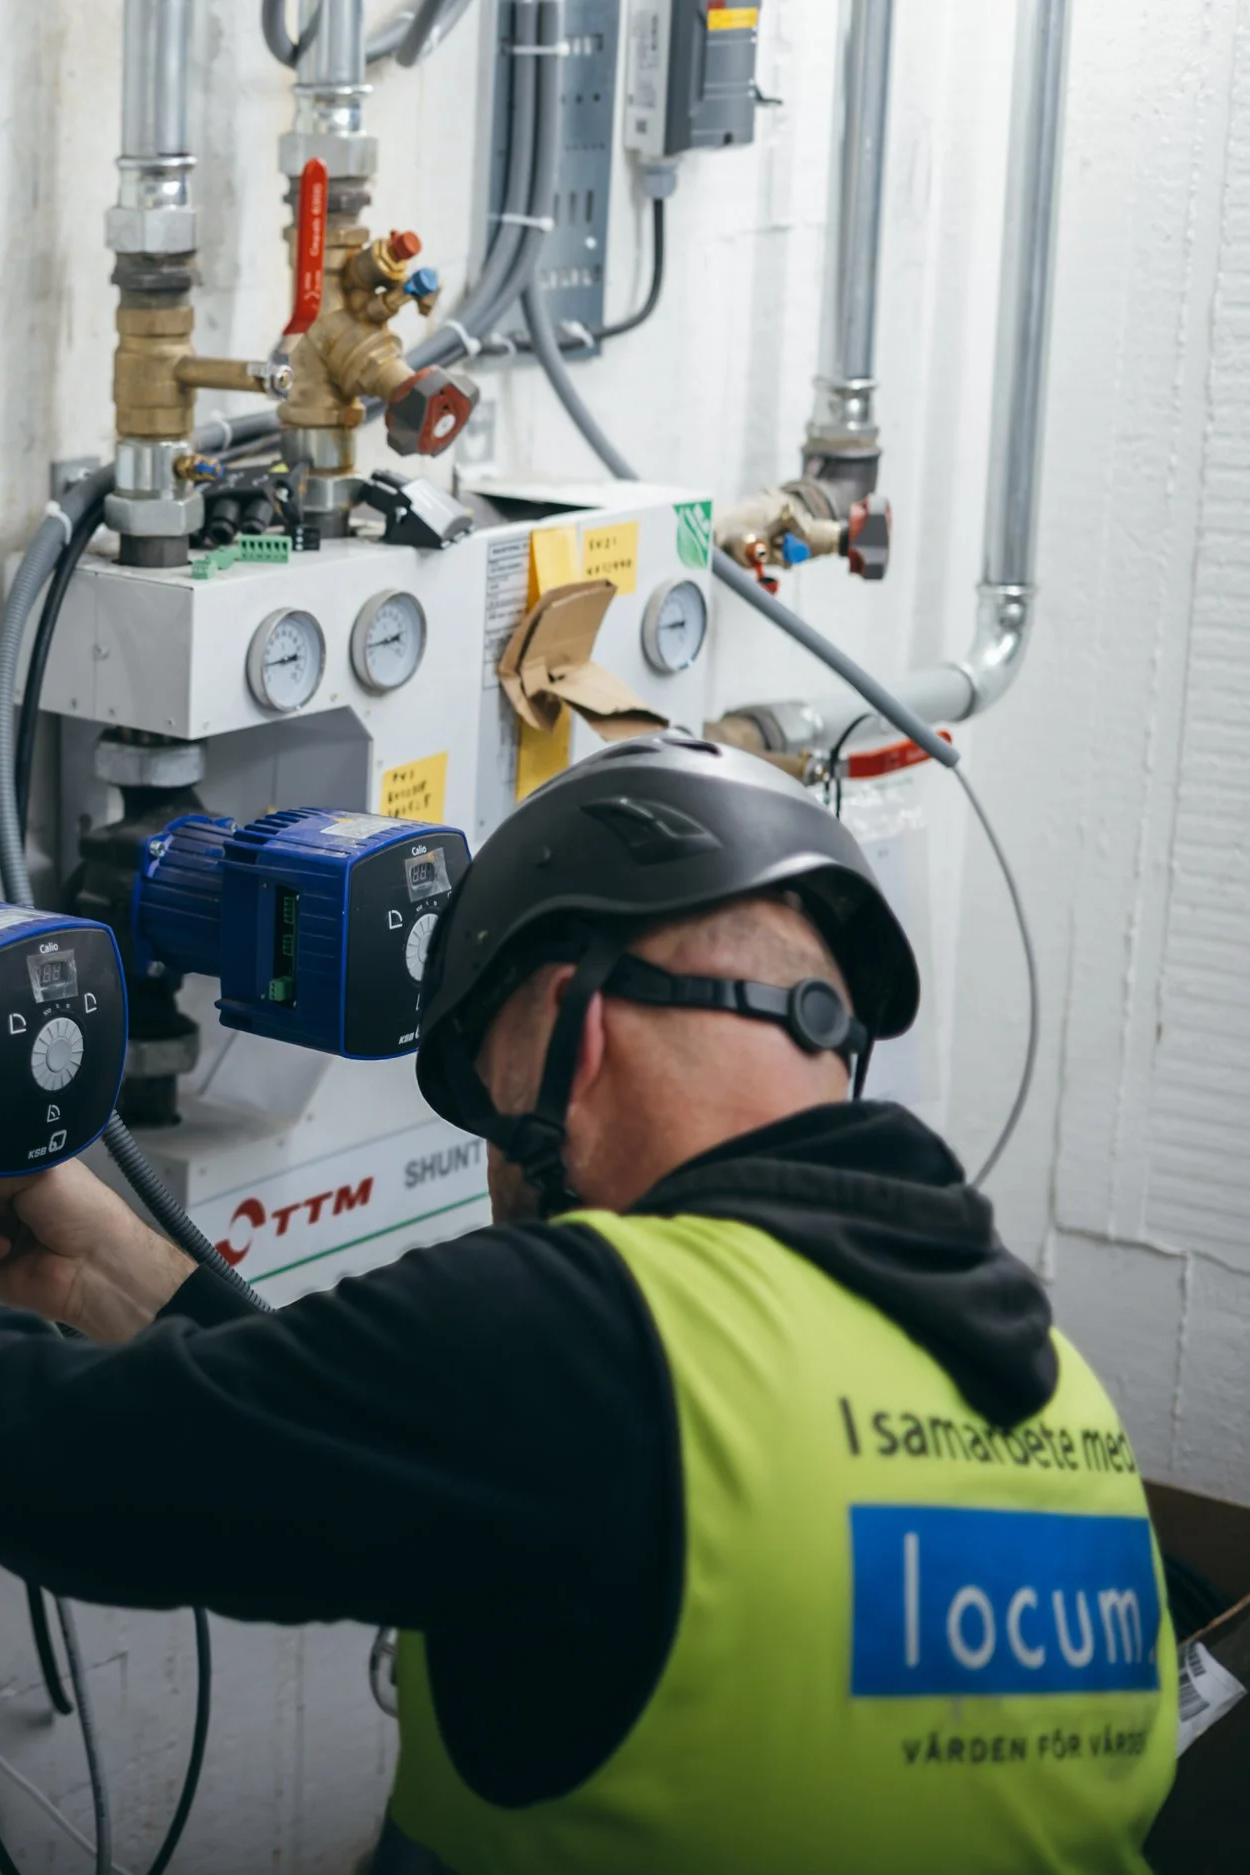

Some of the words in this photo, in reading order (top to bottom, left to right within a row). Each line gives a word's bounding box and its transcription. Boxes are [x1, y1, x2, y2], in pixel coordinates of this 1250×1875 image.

[411, 844, 427, 856] Calio
[39, 942, 59, 954] Calio
[27, 1146, 48, 1160] KSB
[838, 1396, 862, 1457] I
